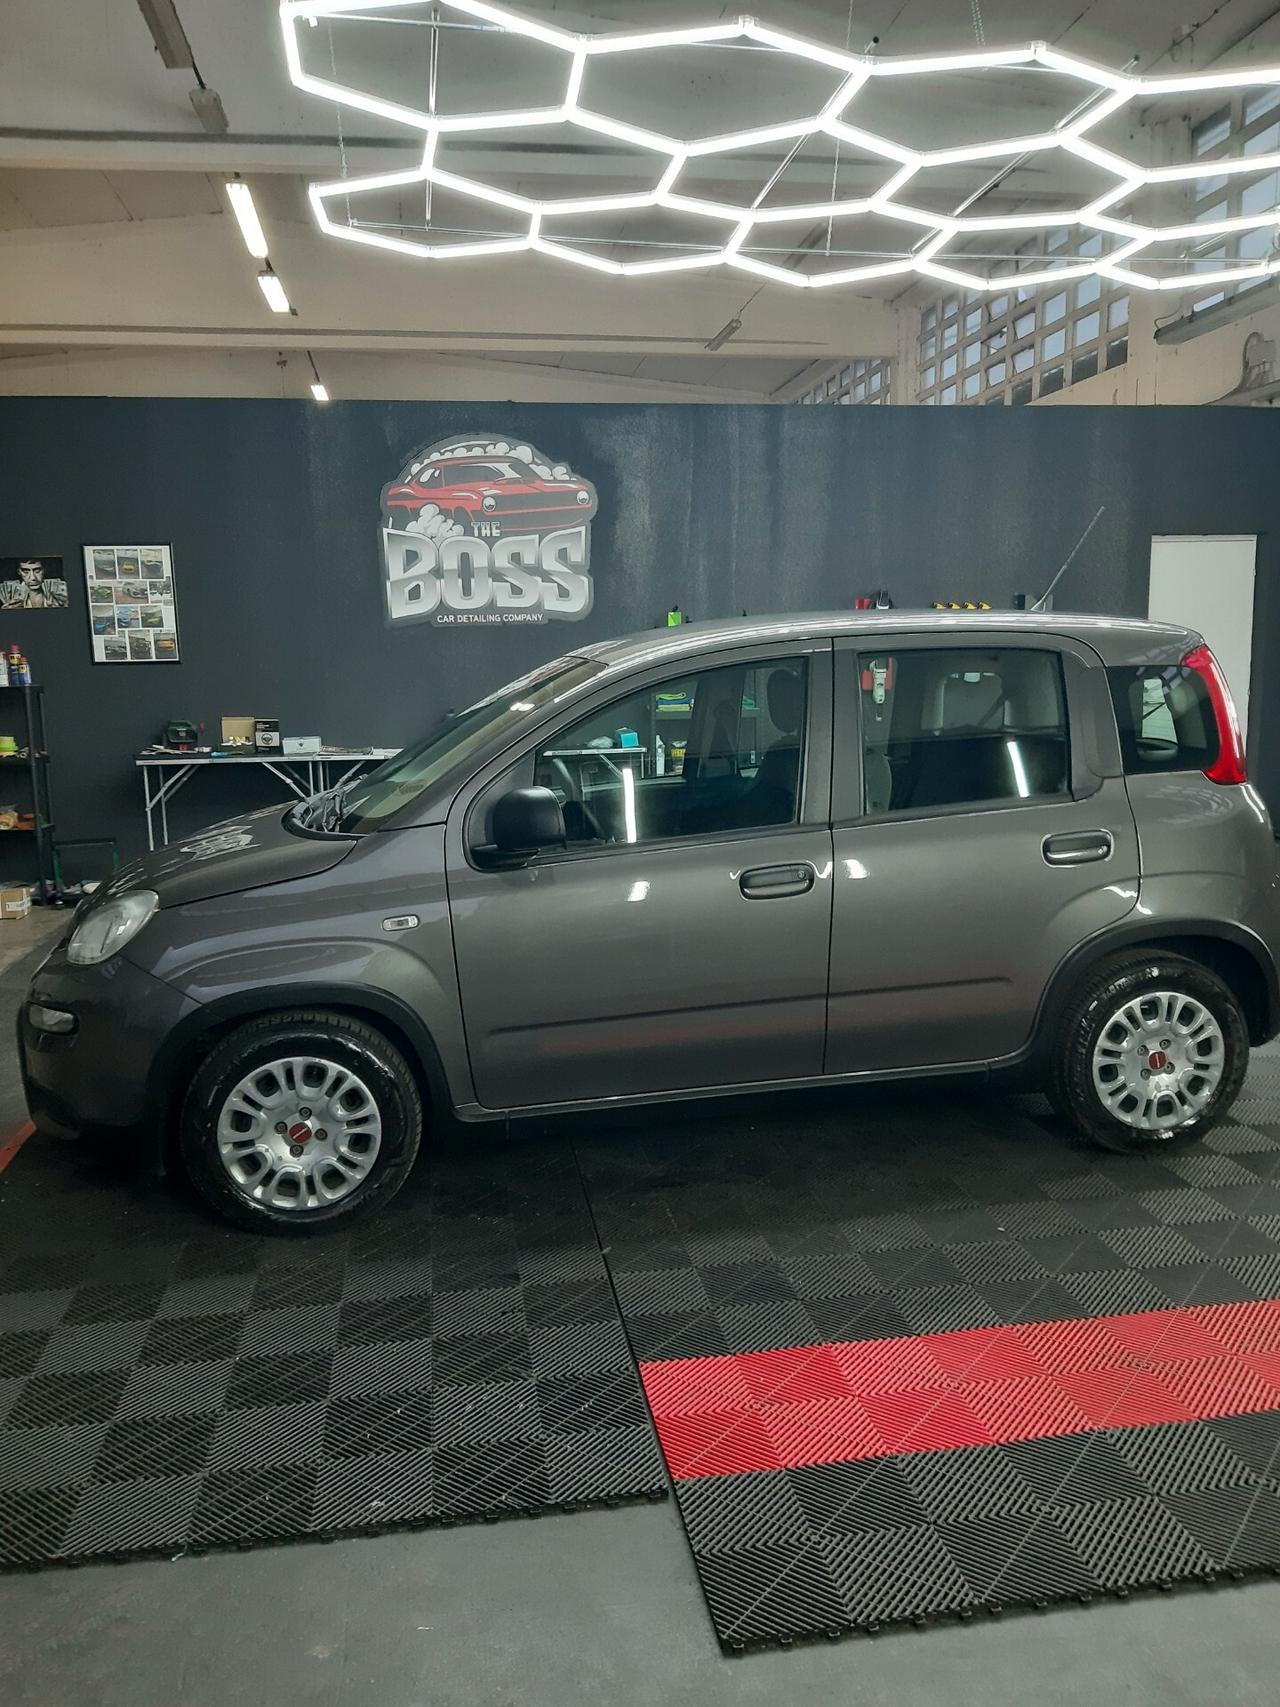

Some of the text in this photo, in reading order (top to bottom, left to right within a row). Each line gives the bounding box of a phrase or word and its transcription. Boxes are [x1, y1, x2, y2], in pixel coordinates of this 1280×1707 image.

[470, 521, 501, 537] THE
[382, 525, 589, 620] BOSS
[437, 613, 543, 623] CAR DETAILING COMPANY
